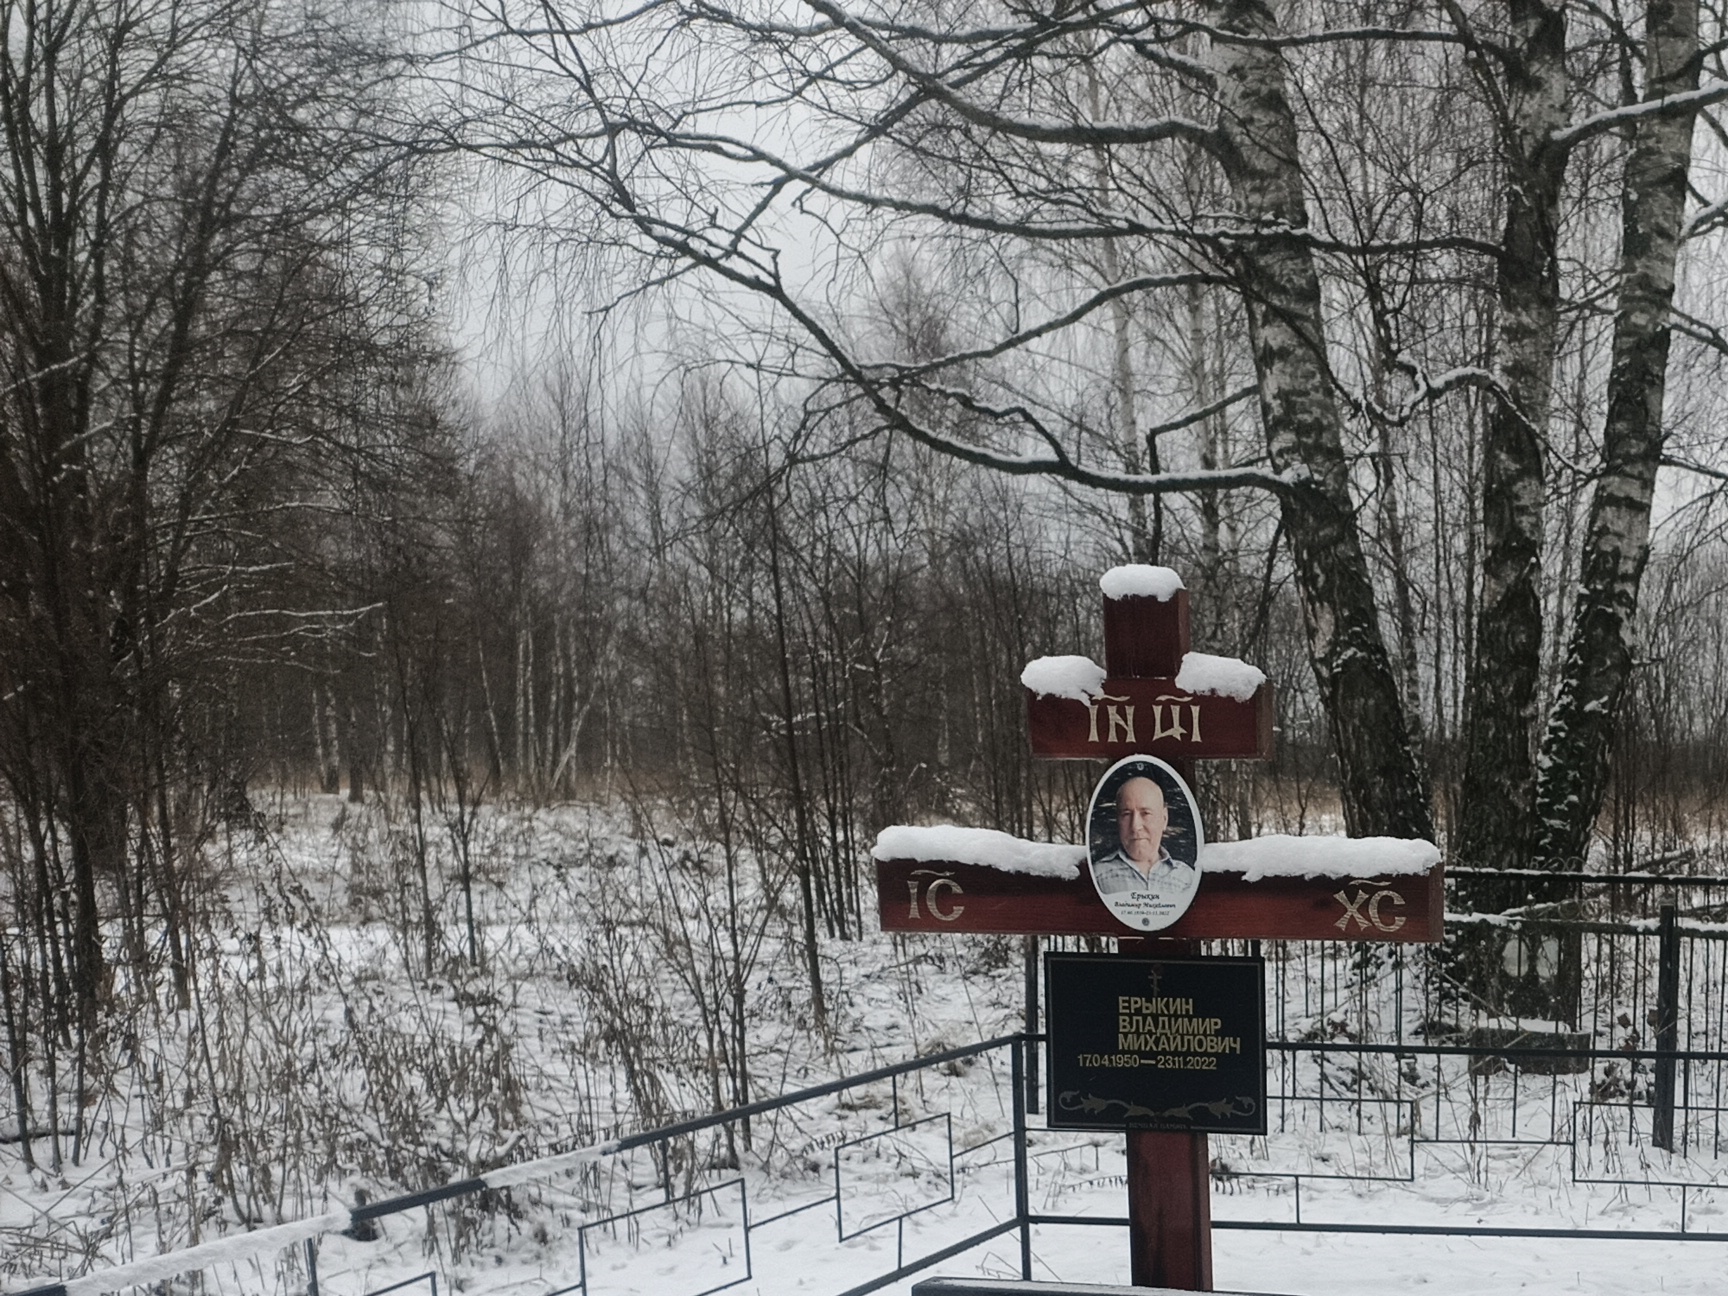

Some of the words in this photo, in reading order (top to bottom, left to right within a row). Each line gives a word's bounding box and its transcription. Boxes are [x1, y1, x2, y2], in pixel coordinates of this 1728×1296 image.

[1130, 891, 1160, 901] Ерыкин
[1118, 996, 1194, 1015] ЕРЫКИН
[1118, 1015, 1222, 1036] ВЛАДИМИР
[1118, 1033, 1241, 1054] МИХАЙЛОВИЧ
